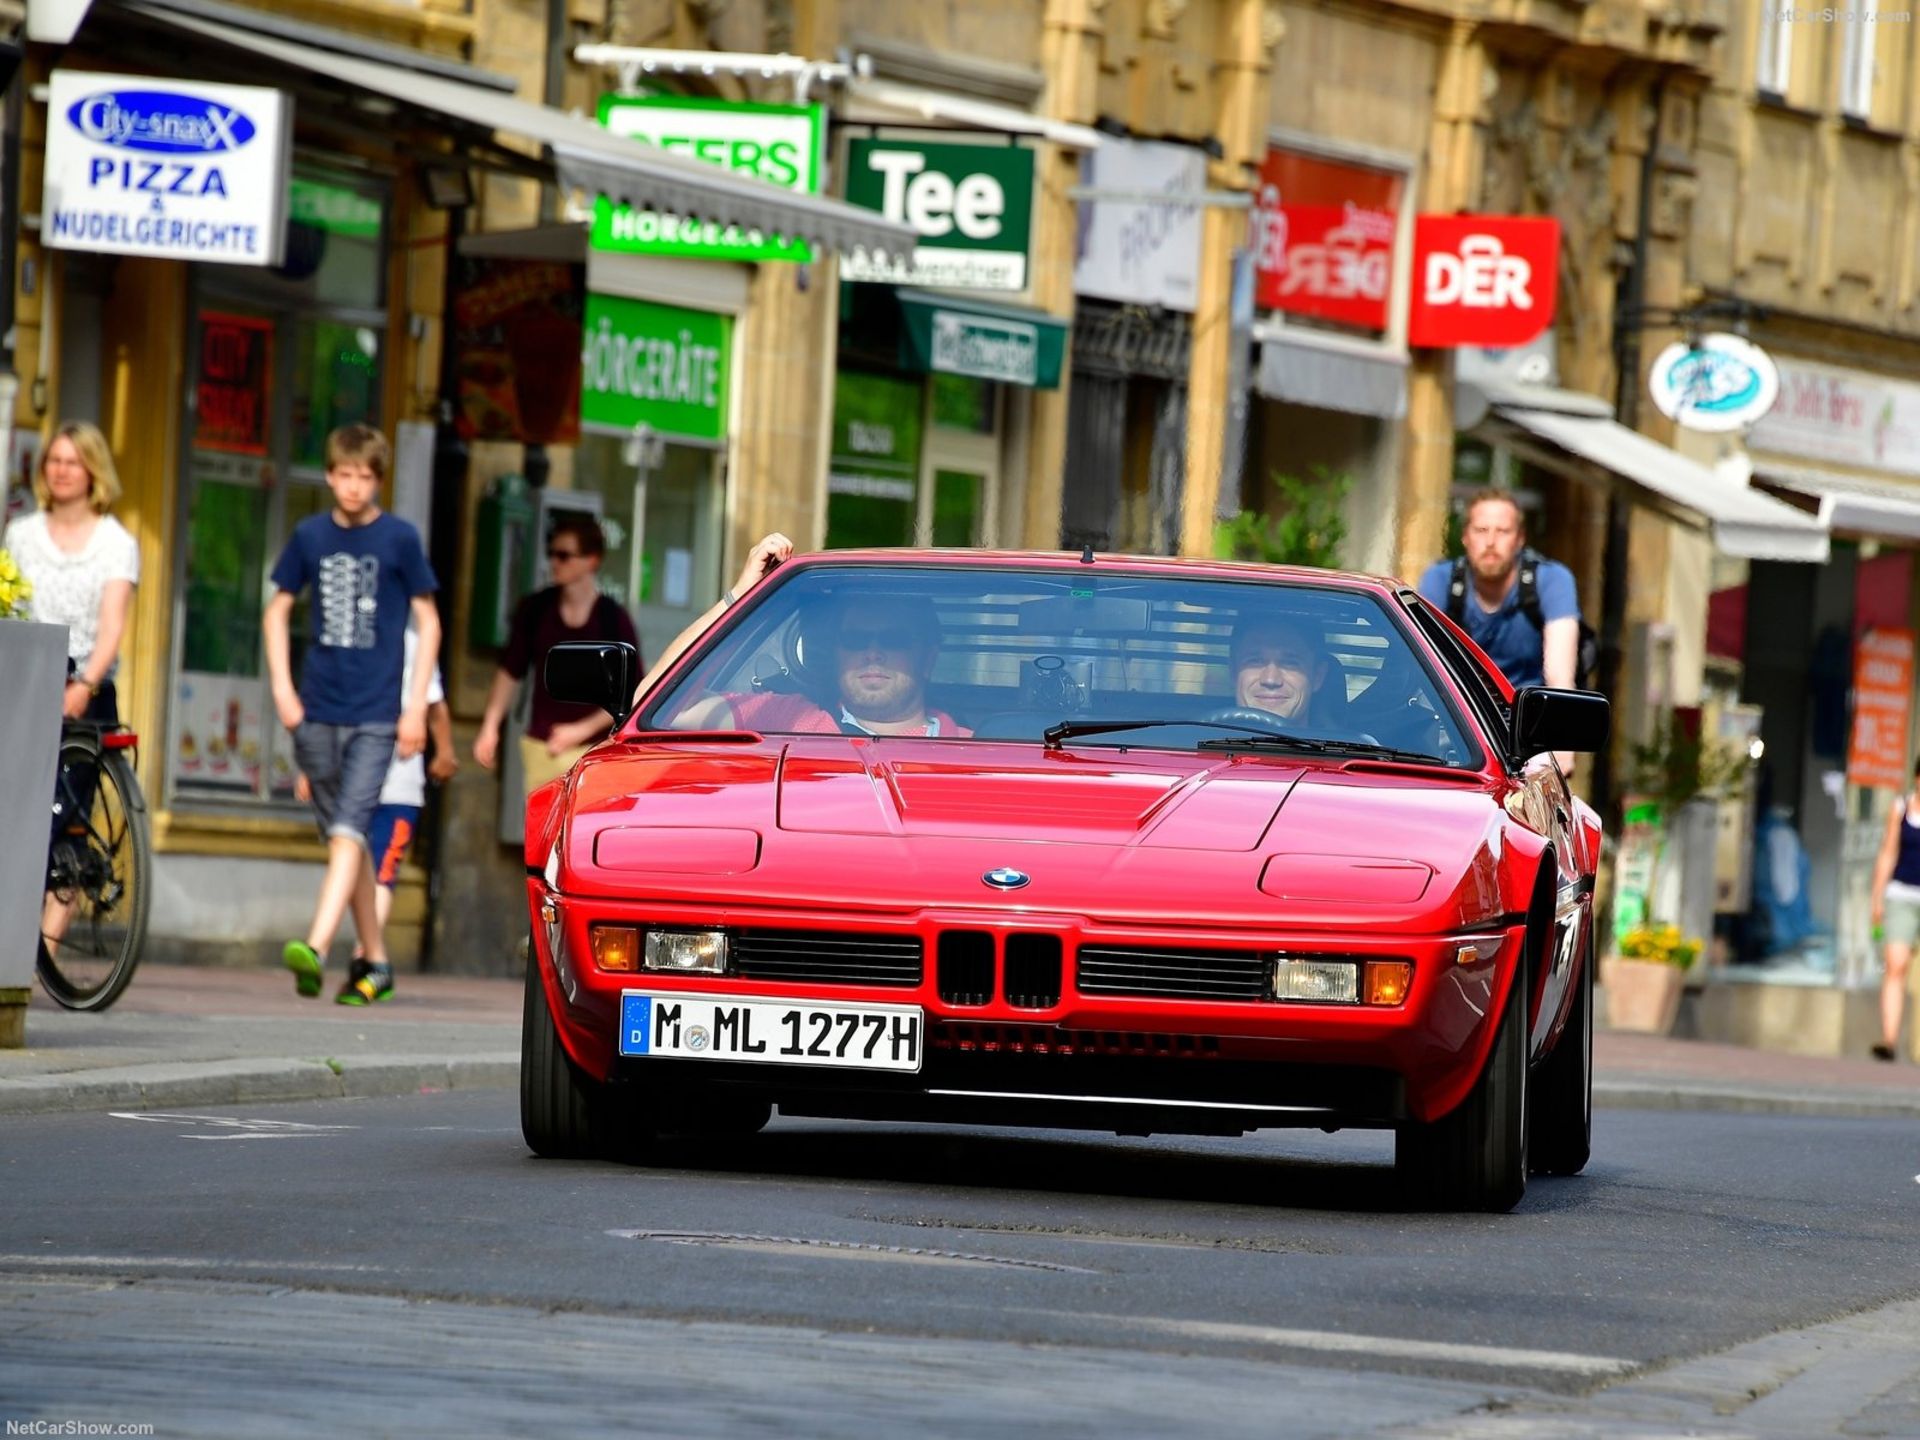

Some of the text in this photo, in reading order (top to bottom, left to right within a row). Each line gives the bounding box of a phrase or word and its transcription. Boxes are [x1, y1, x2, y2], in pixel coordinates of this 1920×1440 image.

[91, 158, 227, 199] PIZZA
[868, 150, 1005, 240] Tee
[53, 211, 257, 253] NUDELGERICHTE
[1424, 252, 1534, 310] DER
[630, 1030, 642, 1044] D
[655, 1003, 918, 1061] M ML 1277H
